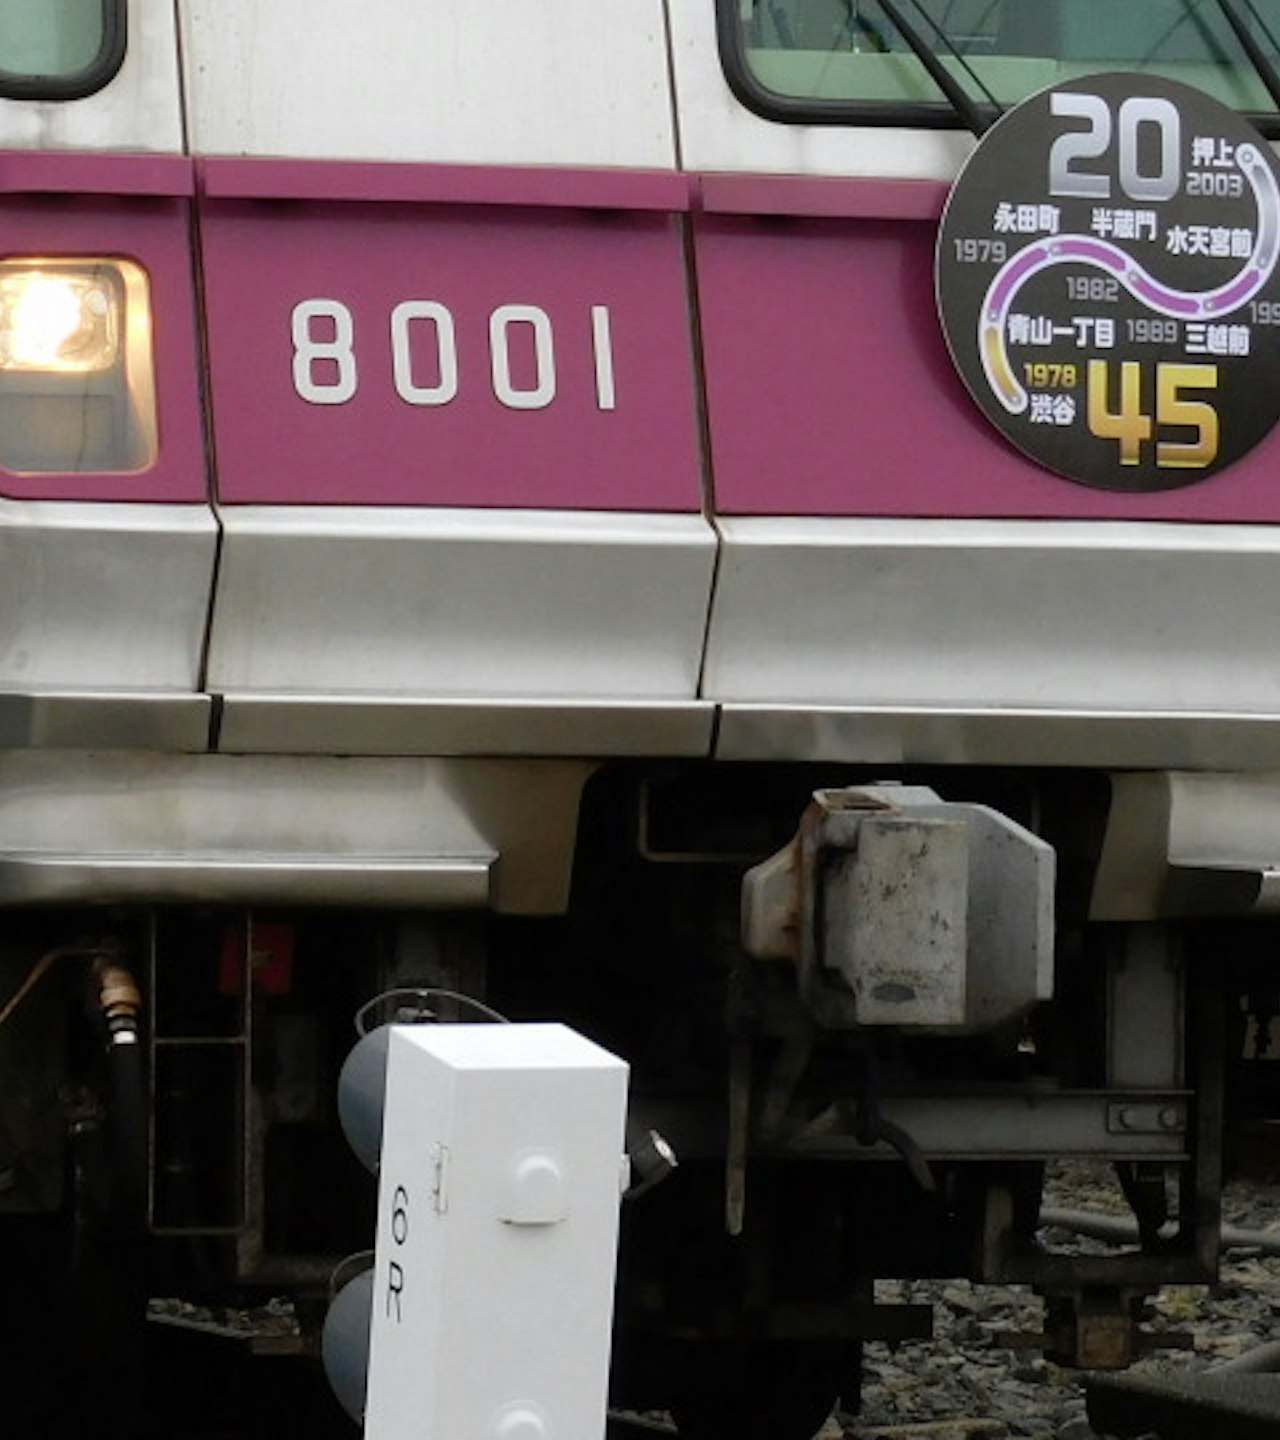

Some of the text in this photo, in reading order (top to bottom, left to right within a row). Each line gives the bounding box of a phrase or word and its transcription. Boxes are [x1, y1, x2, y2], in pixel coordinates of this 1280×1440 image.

[1049, 92, 1181, 201] 20
[1192, 137, 1235, 168] 押上
[1186, 172, 1244, 198] 2003
[993, 202, 1061, 235] 永田町
[1091, 208, 1158, 241] 半蔵門
[954, 239, 1007, 262] 1979
[1166, 226, 1253, 259] 水天宮前
[1066, 277, 1119, 302] 1982
[1007, 313, 1115, 348] 青山一丁目
[1127, 319, 1178, 344] 1989
[1185, 324, 1251, 356] 三越前
[291, 299, 616, 411] 8001
[1025, 364, 1077, 388] 1978
[1030, 393, 1076, 425] 渋谷
[1087, 359, 1220, 469] 45
